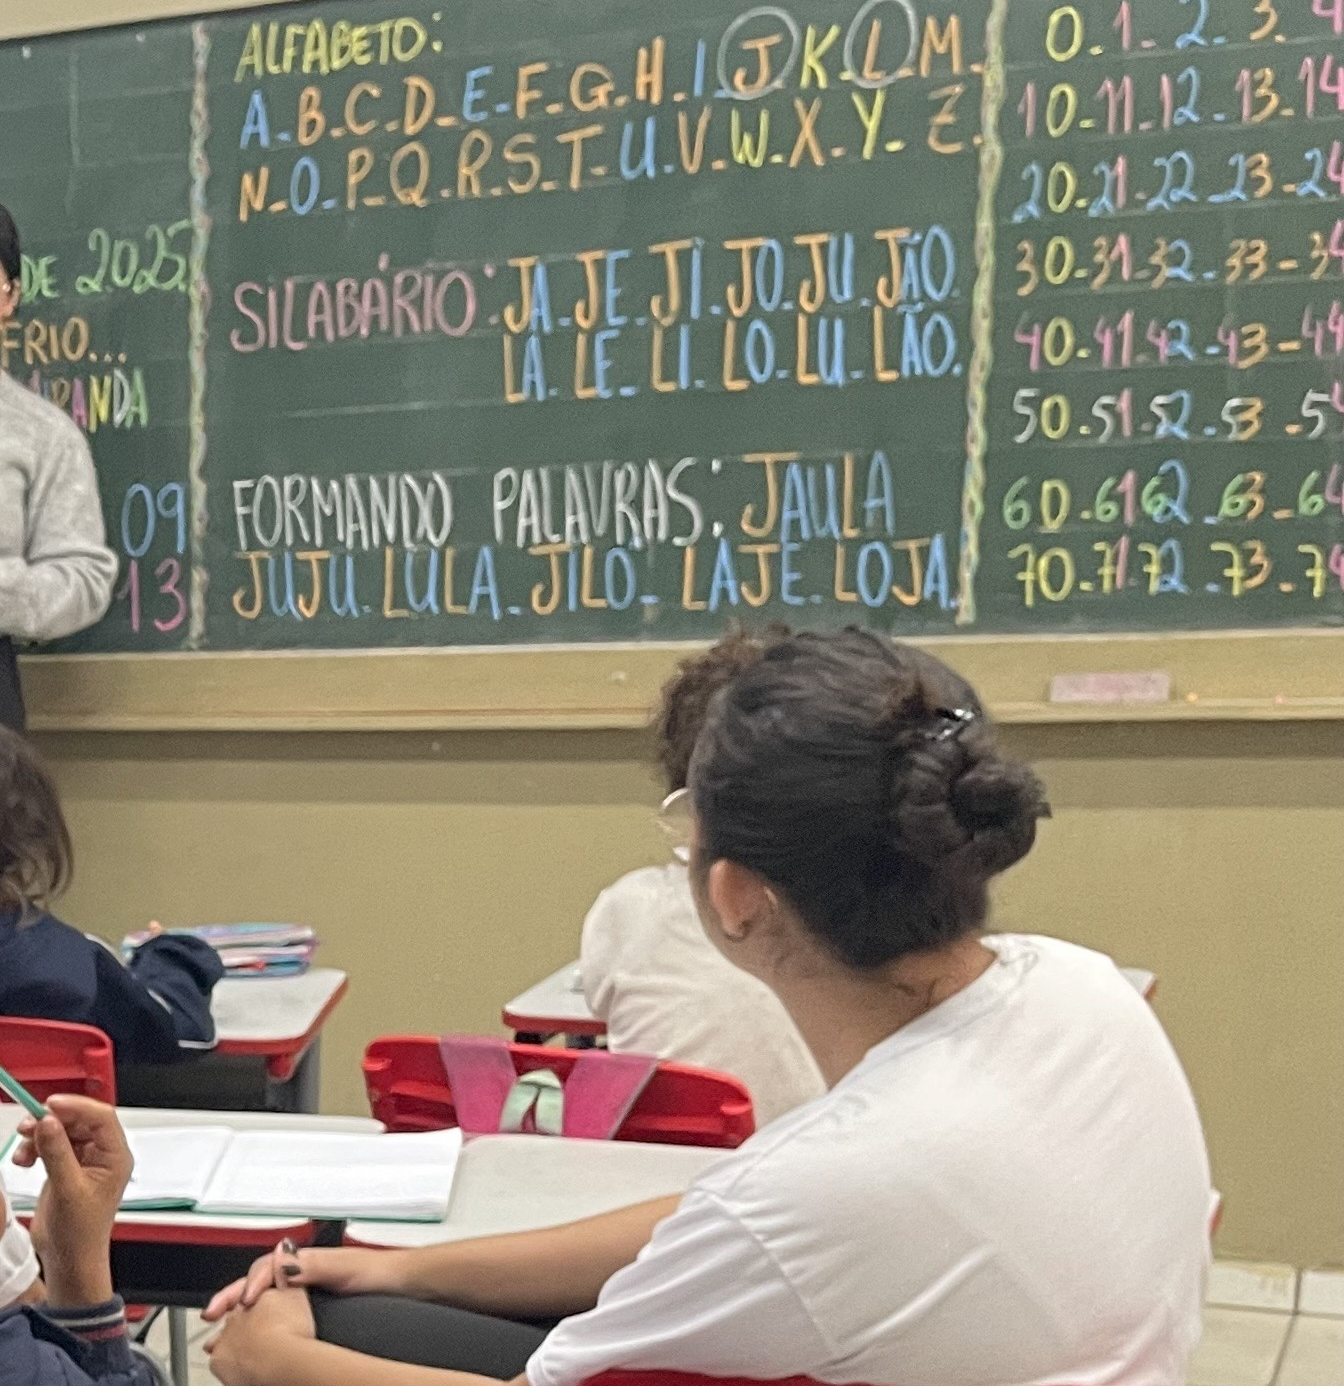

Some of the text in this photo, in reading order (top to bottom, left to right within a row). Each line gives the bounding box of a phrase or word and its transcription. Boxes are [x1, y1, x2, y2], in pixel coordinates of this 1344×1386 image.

[121, 481, 186, 557] 09
[233, 472, 451, 549] FORMANDO
[741, 450, 895, 540] JAULA
